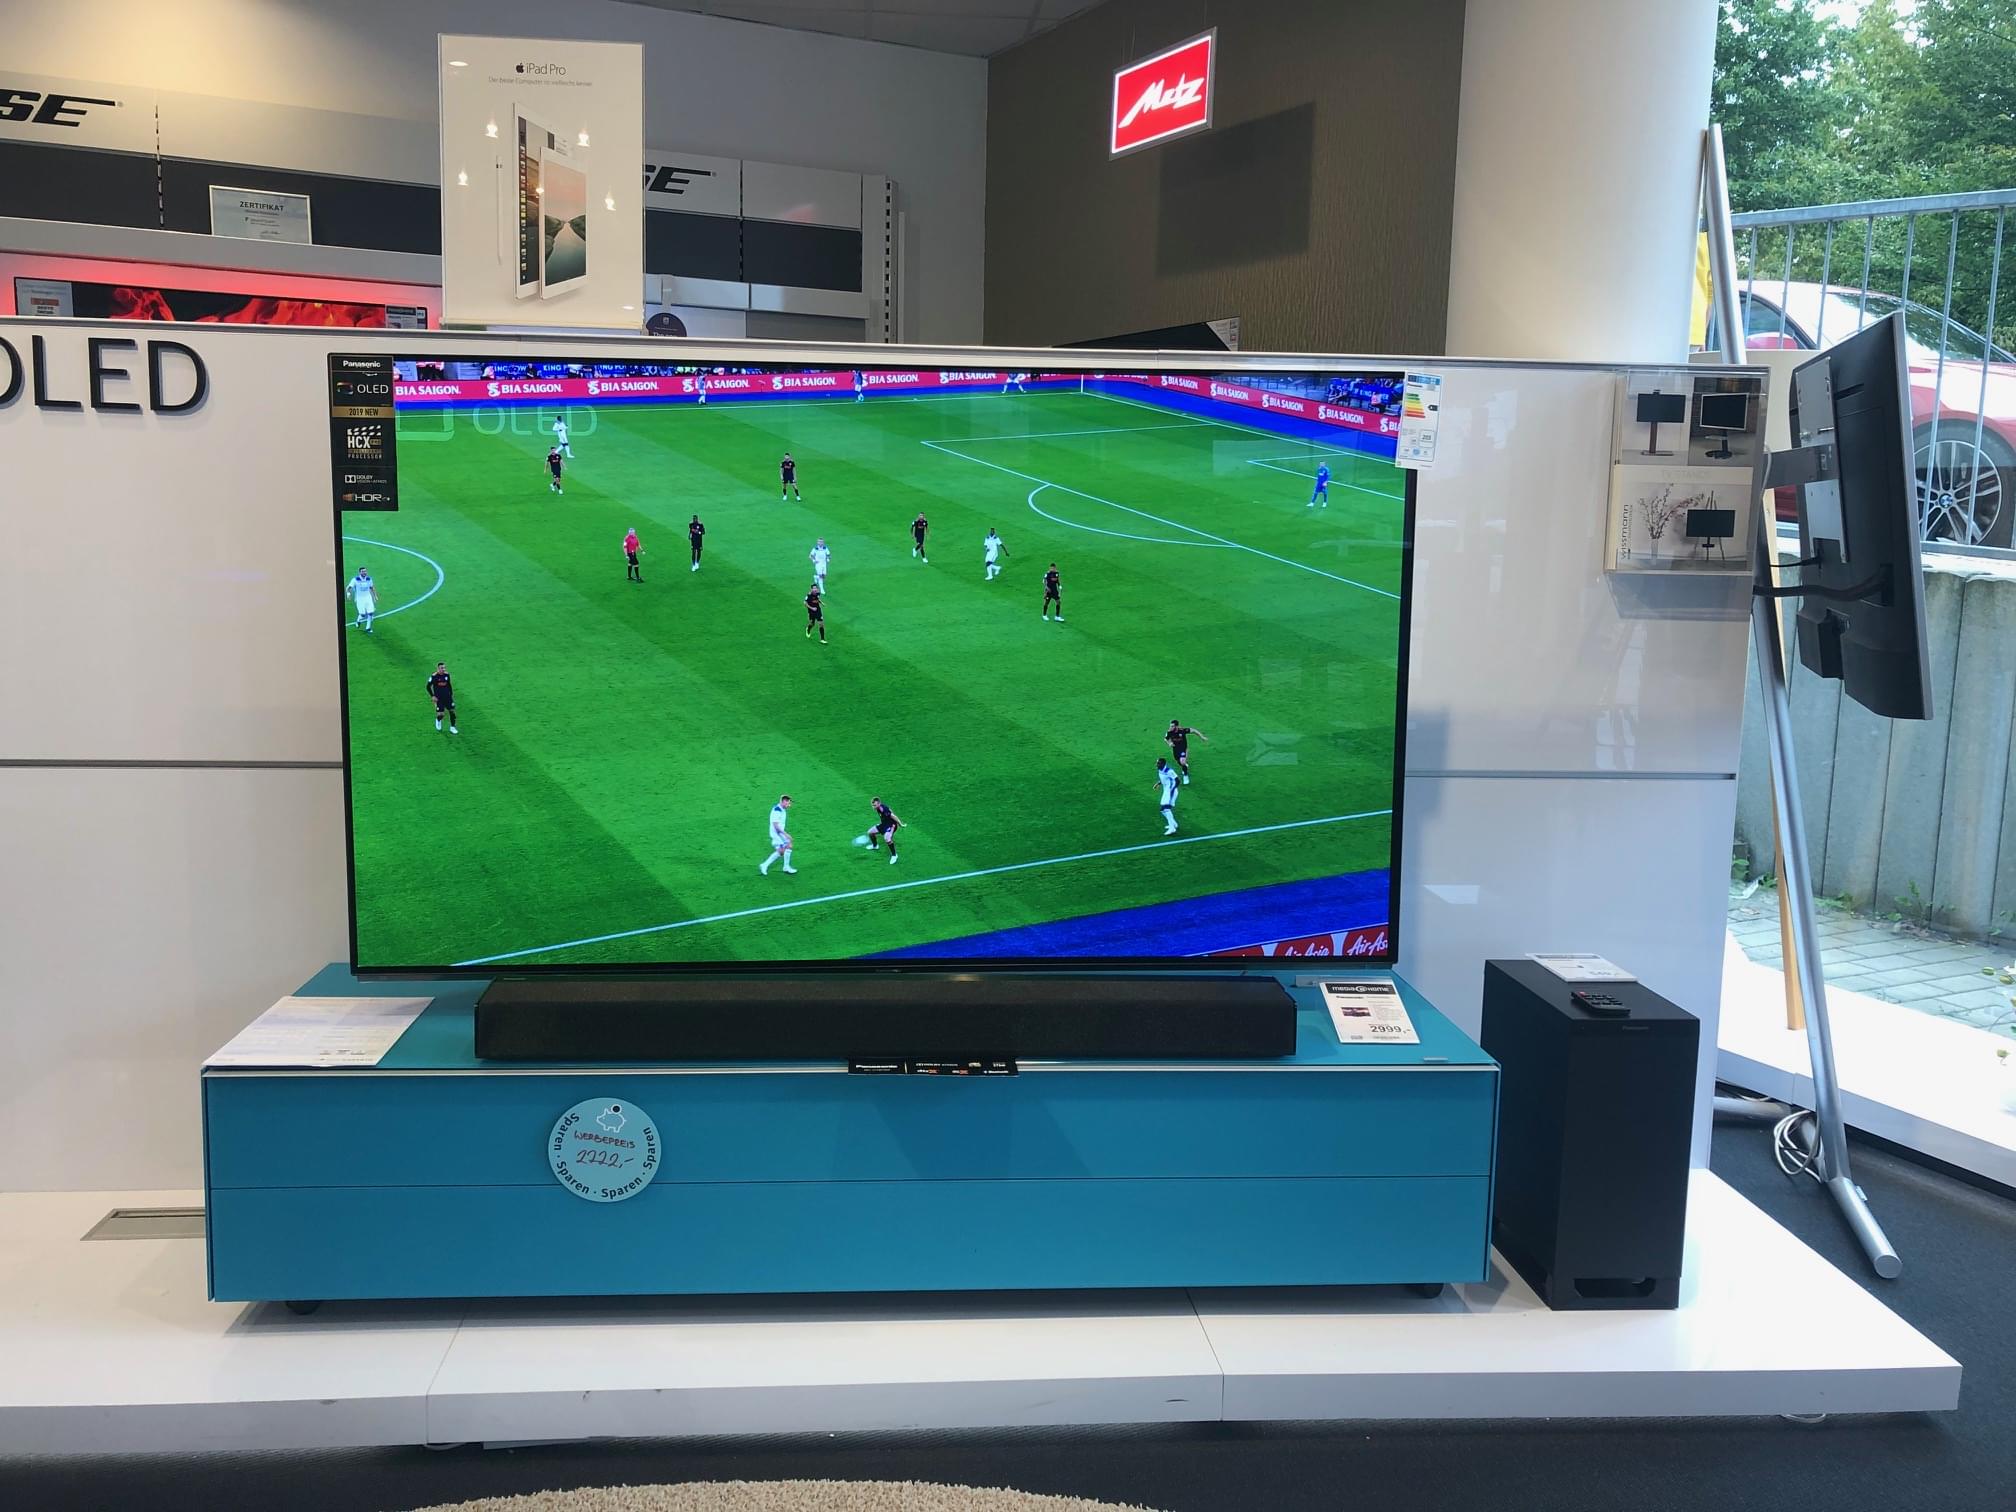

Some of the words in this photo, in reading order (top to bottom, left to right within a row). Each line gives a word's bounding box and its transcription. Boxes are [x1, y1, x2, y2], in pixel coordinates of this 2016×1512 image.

[526, 62, 548, 75] iPad
[549, 64, 567, 76] Pro
[1118, 73, 1205, 129] Metz
[240, 201, 284, 211] ZERTIFIKAT
[343, 360, 381, 368] Panasonic
[784, 377, 802, 387] BIA
[869, 375, 887, 384] BIA
[357, 384, 389, 394] OLED
[395, 386, 416, 395] BIA
[501, 383, 522, 394] BIA
[601, 382, 621, 392] BIA
[349, 408, 363, 416] 2019
[365, 408, 379, 416] NEW
[347, 436, 371, 448] HCX
[554, 1112, 580, 1151] Sparen
[574, 1130, 636, 1149] WERBEPREIS
[643, 1127, 657, 1170] Sparen
[557, 1161, 590, 1194] Sparen
[601, 1177, 643, 1200] Sparen
